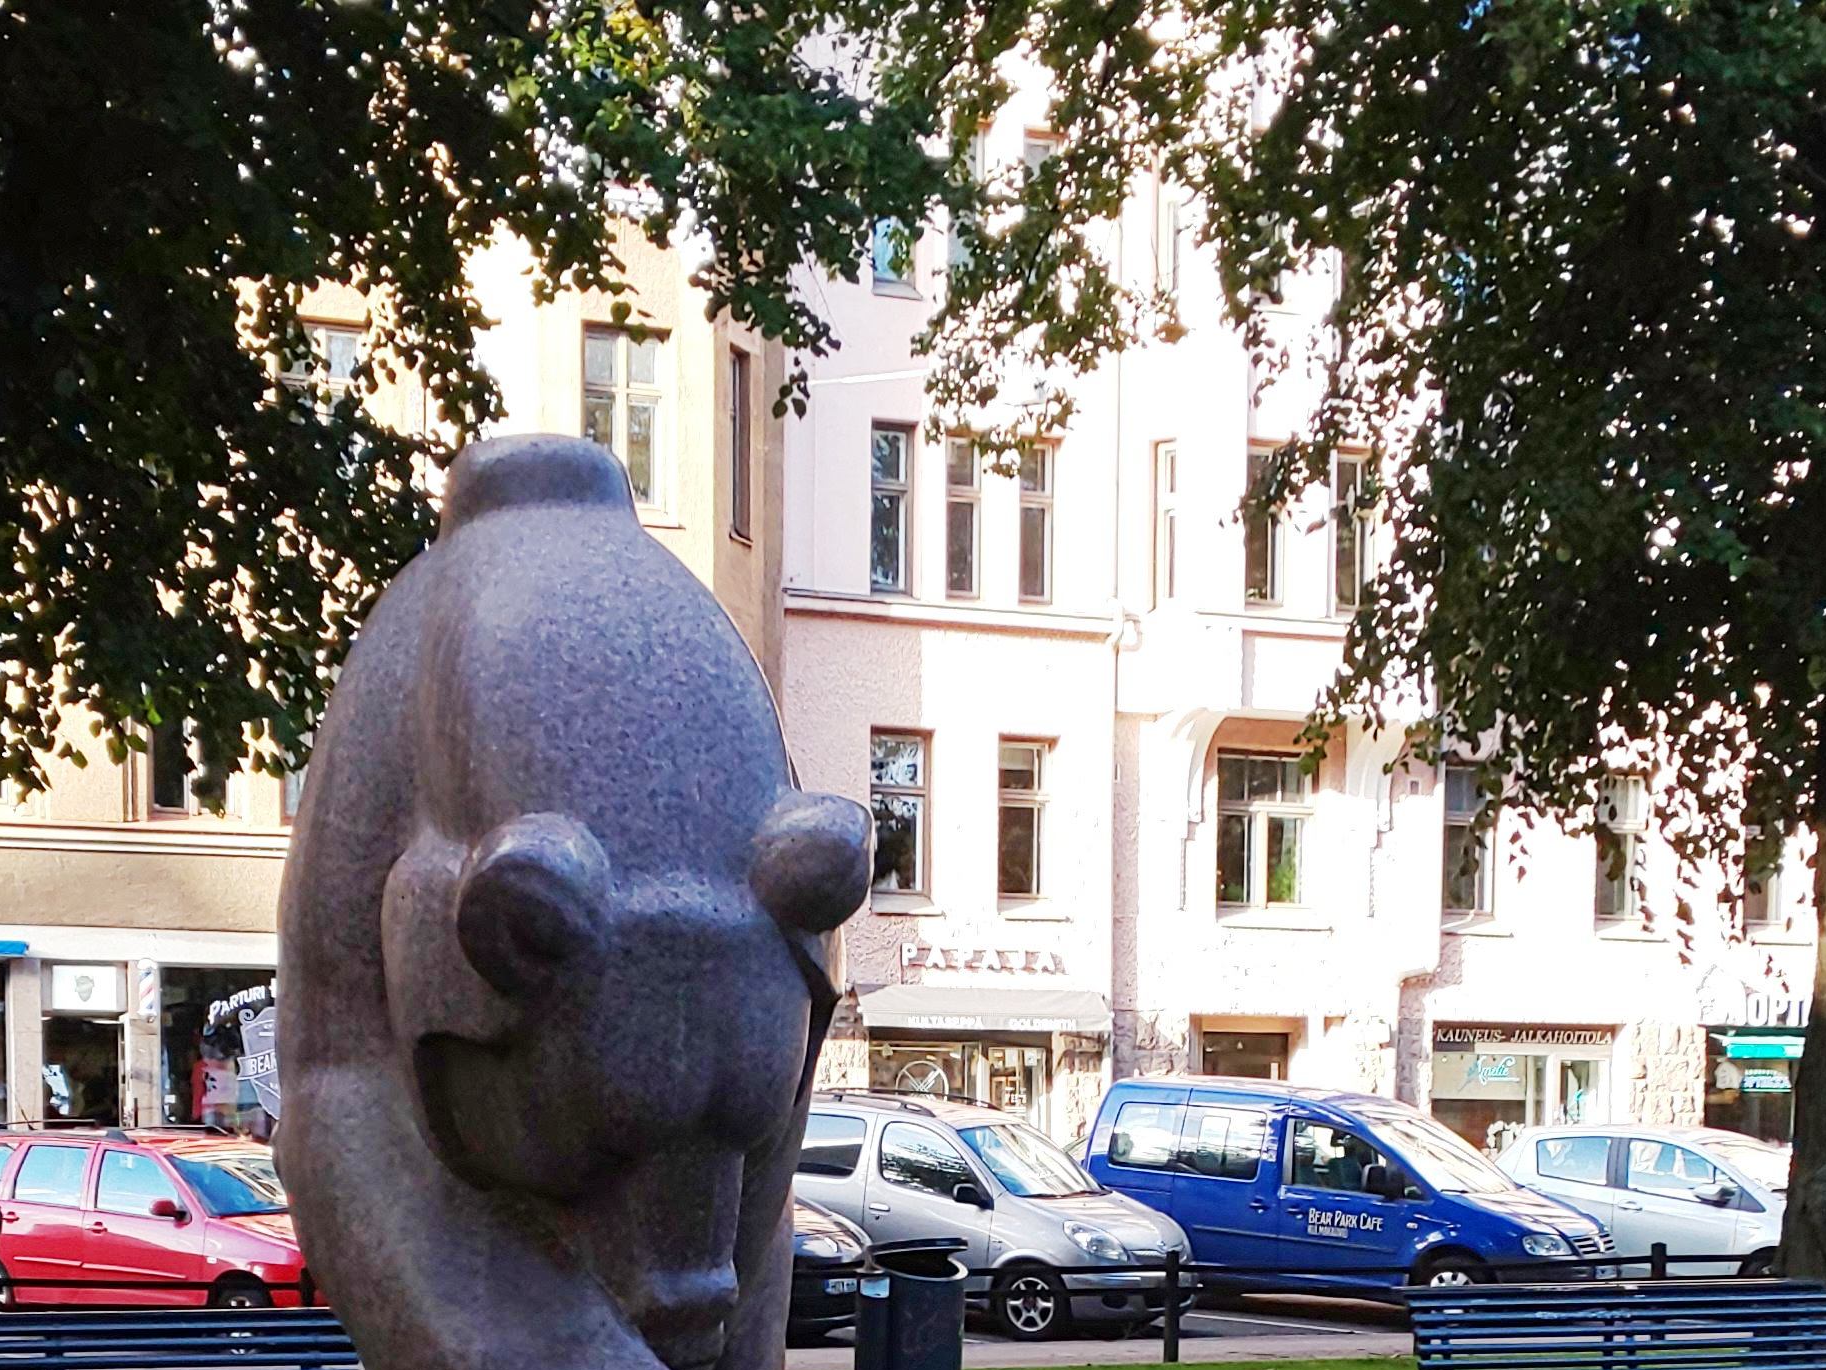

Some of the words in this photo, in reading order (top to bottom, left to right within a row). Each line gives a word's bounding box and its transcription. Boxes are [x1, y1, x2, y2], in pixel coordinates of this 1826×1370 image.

[207, 985, 265, 1024] PARTURI
[1437, 1028, 1507, 1043] KAUNEUS-
[1511, 1030, 1612, 1044] JALKAHOITOLA
[1309, 1208, 1332, 1225] BEAR
[1335, 1211, 1357, 1228] PARK
[1360, 1213, 1383, 1231] CAFE
